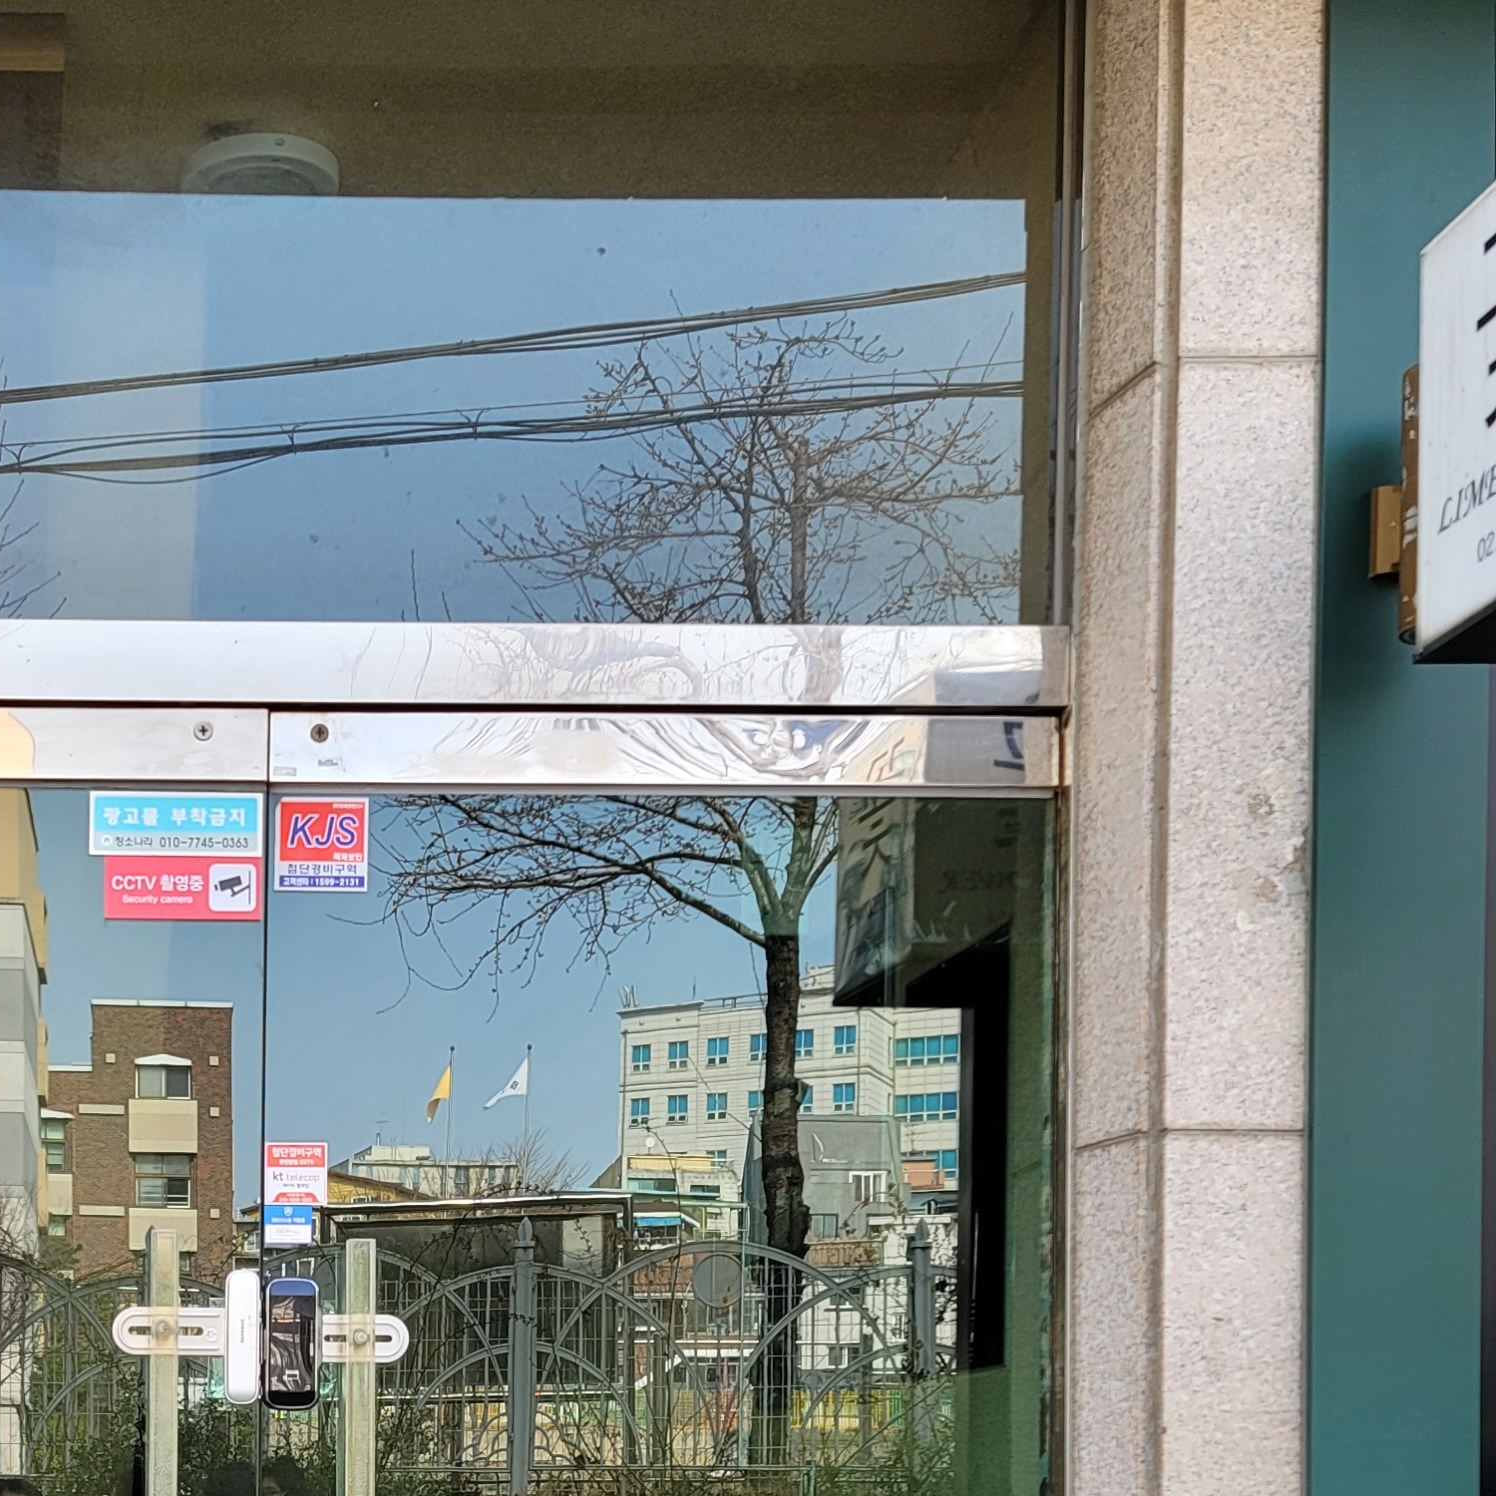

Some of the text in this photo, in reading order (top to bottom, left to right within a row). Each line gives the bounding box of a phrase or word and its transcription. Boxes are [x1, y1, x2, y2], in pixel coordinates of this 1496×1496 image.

[103, 807, 246, 827] 광고물 부착금지
[287, 814, 359, 848] KJS
[115, 836, 249, 849] 청소나라 010-7745-0363
[288, 864, 357, 875] 첨단경비구역
[111, 876, 205, 892] CCTV 촬영중
[122, 894, 193, 906] Security camera
[272, 1147, 322, 1159] 첨단경비구역
[272, 1171, 320, 1183] kt telecop
